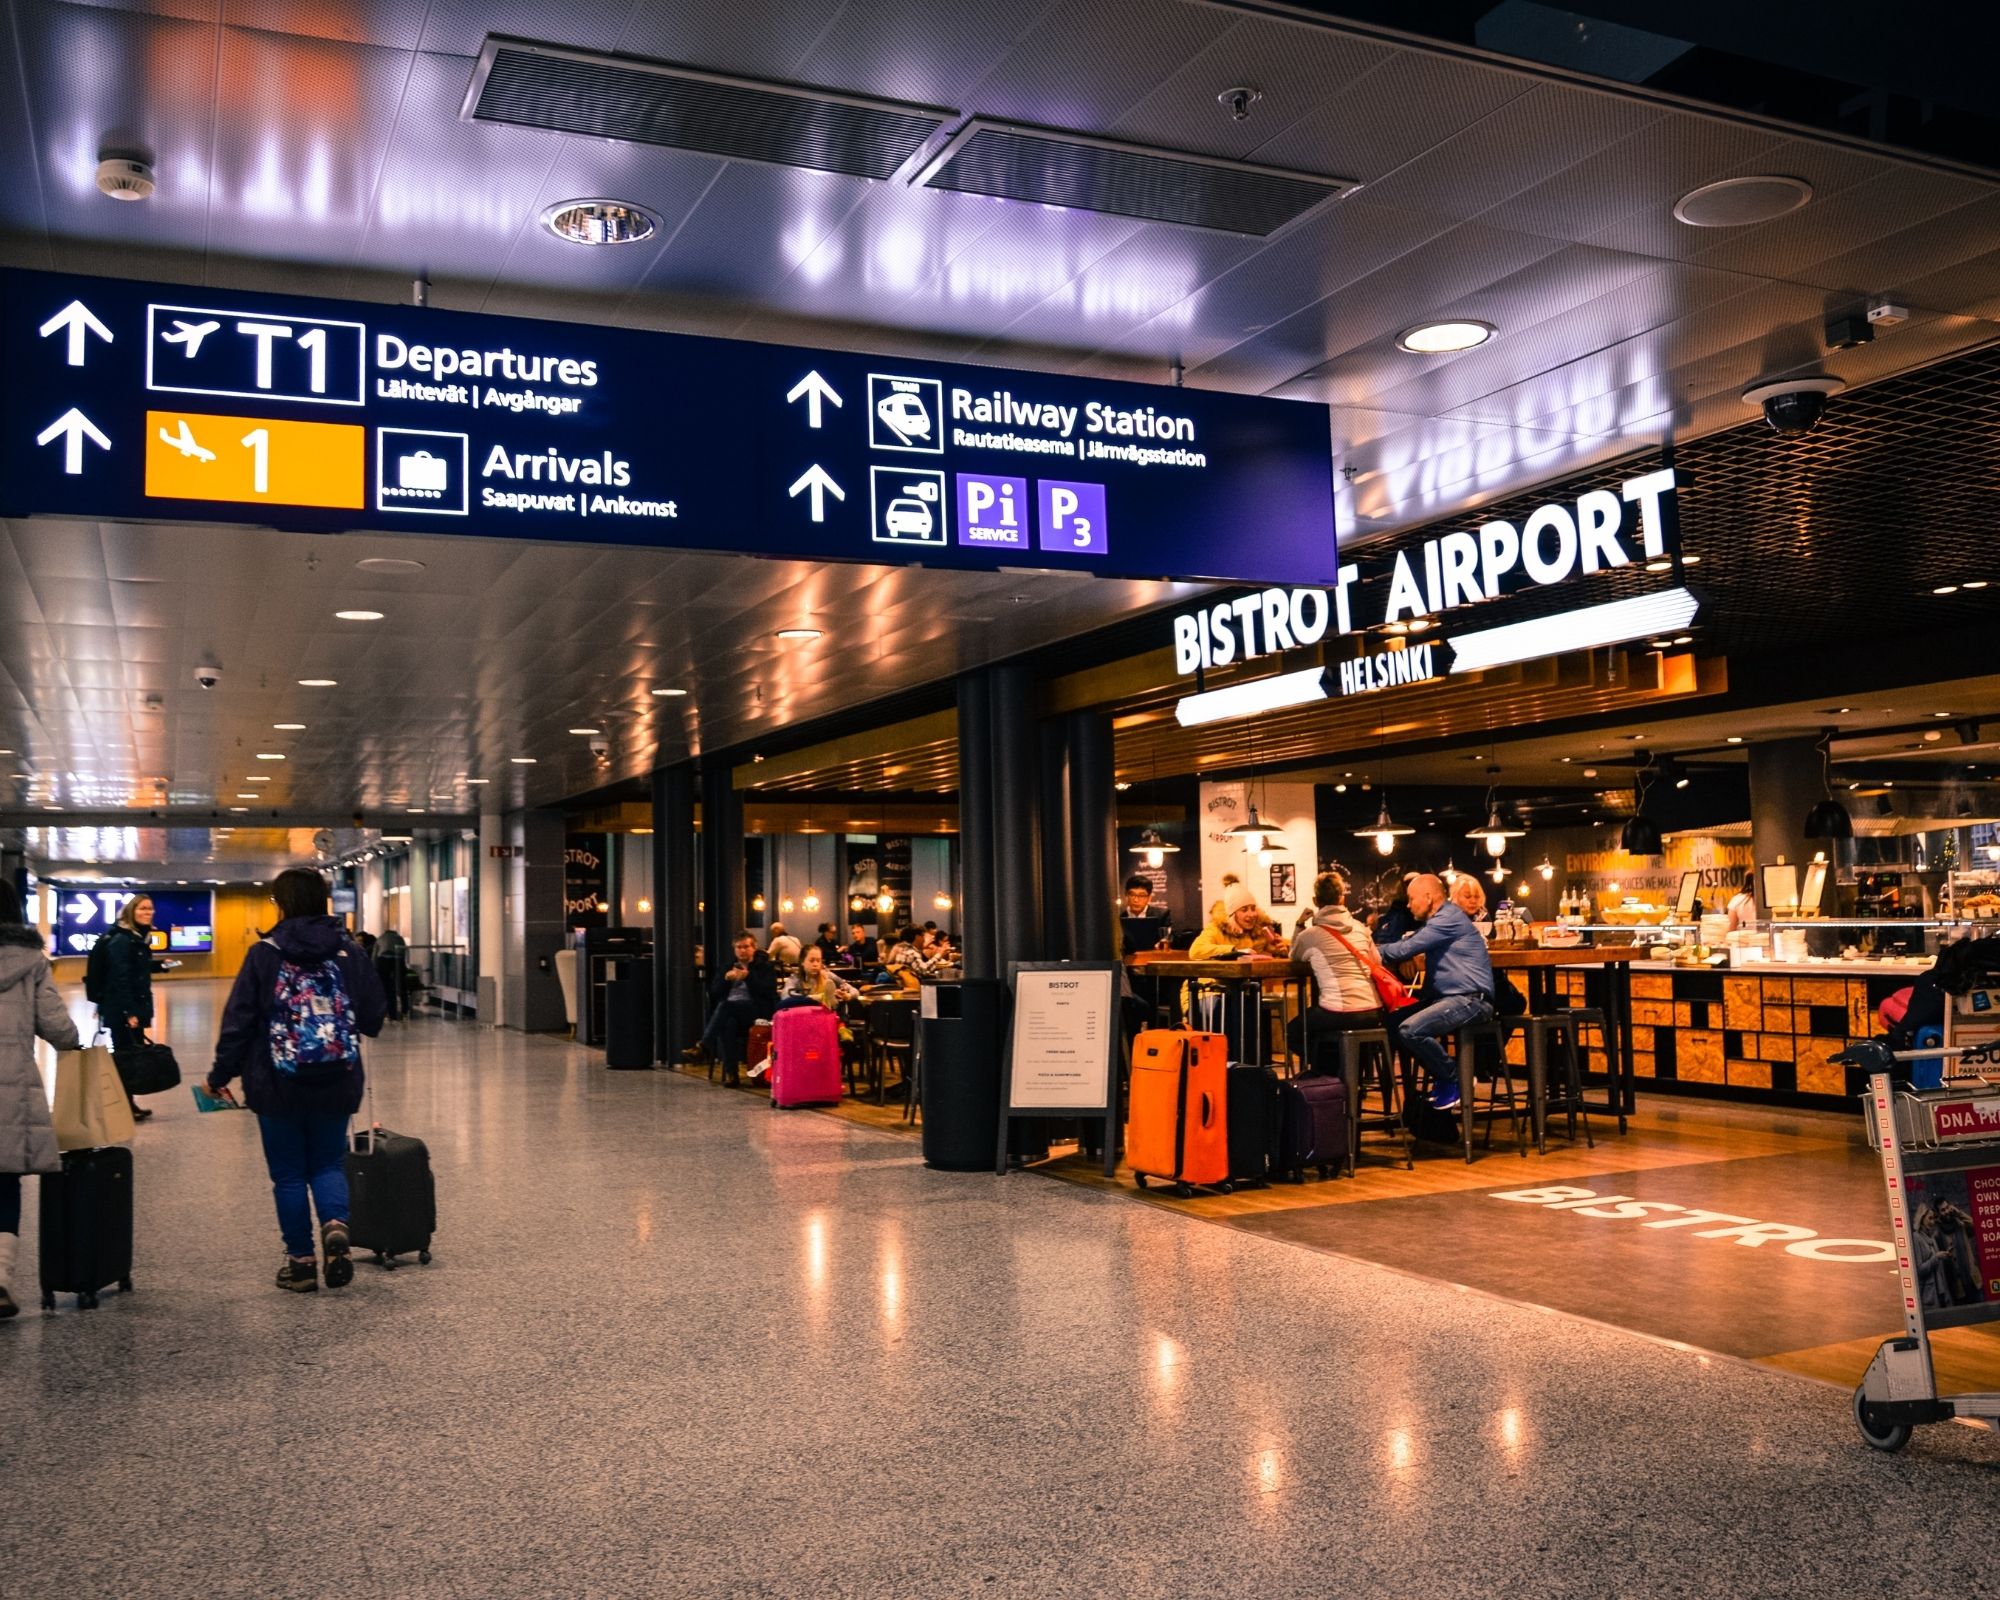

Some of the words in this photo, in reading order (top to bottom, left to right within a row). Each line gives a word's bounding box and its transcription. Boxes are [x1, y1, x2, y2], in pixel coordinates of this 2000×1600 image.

[238, 322, 325, 393] T1
[378, 335, 597, 386] Departures
[378, 379, 468, 403] Lähtevät
[484, 388, 581, 415] Avgångar
[953, 389, 1077, 437] Railway
[1086, 402, 1194, 441] Station
[242, 429, 268, 492] 1
[482, 445, 630, 486] Arrivals
[954, 429, 1074, 455] Rautatieasema
[1087, 441, 1206, 467] Järnvägsstation
[483, 488, 575, 512] Saapuvat
[590, 495, 677, 517] Ankomst
[967, 482, 1017, 526] Pi
[969, 527, 1018, 542] SERVICE
[1174, 564, 1359, 676] BISTROT
[1385, 468, 1676, 624] AIRPORT
[1340, 644, 1433, 696] HELSINKI
[1208, 796, 1237, 813] BISTROT
[1941, 1112, 1975, 1128] DNA
[1979, 1110, 2000, 1125] PR
[1976, 1191, 2000, 1203] OWN
[1487, 1185, 1899, 1273] BISTRO
[1981, 1219, 1994, 1229] 4G
